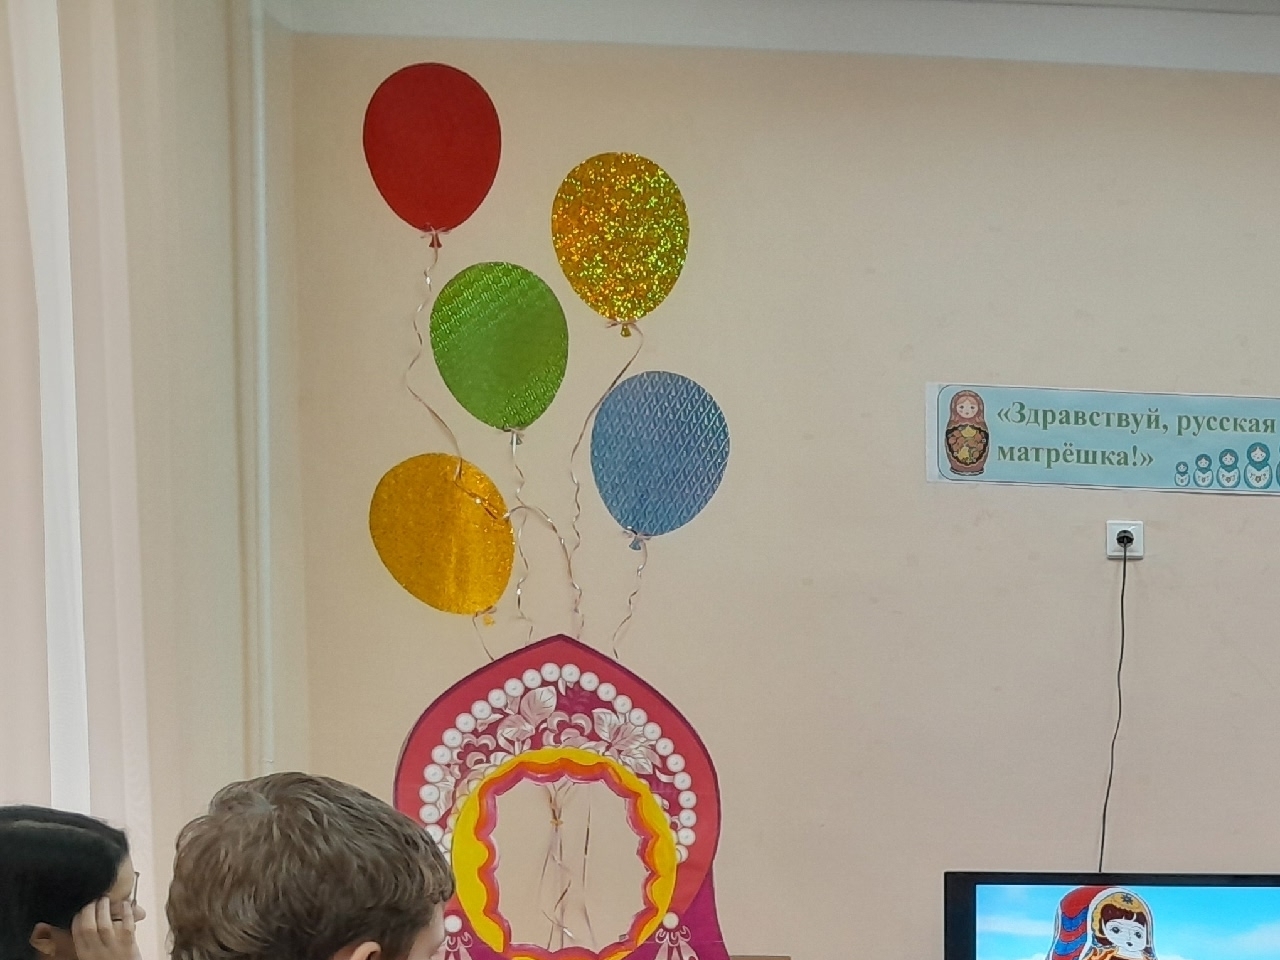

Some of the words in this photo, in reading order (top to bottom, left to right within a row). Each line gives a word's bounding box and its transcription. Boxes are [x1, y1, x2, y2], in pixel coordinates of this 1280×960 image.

[997, 401, 1169, 434] «Здравствуй,
[1176, 415, 1277, 436] русская
[997, 443, 1154, 469] матрёшка!»
